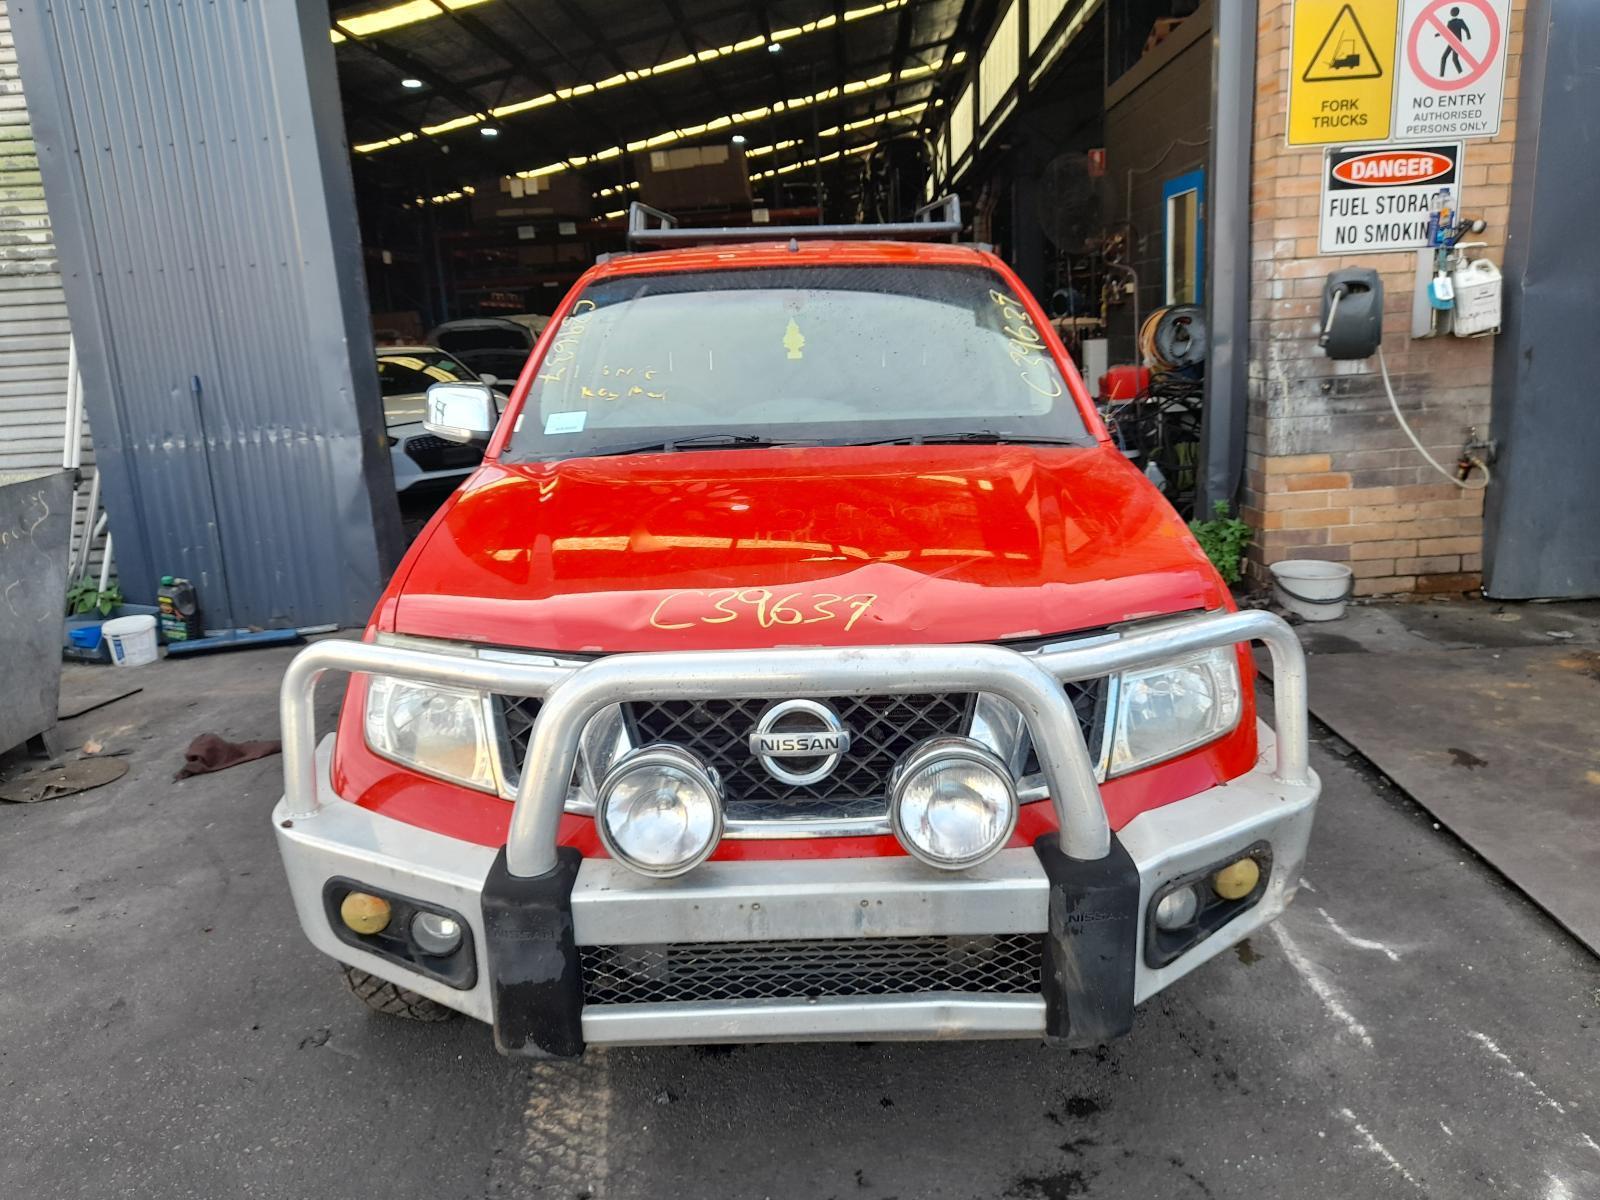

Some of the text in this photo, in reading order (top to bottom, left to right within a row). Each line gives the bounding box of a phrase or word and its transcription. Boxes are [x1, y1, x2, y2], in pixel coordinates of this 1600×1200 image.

[1320, 98, 1360, 113] FORK
[1412, 93, 1486, 109] NO ENTRY
[1311, 113, 1369, 129] TRUCKS
[1413, 109, 1483, 123] AUTHORISED
[1406, 121, 1488, 135] PERSONS ONLY
[1350, 157, 1434, 180] DANGER
[1329, 196, 1369, 217] FUEL
[1335, 225, 1358, 245] NO
[650, 588, 878, 632] C39637
[760, 736, 840, 752] NISSAN
